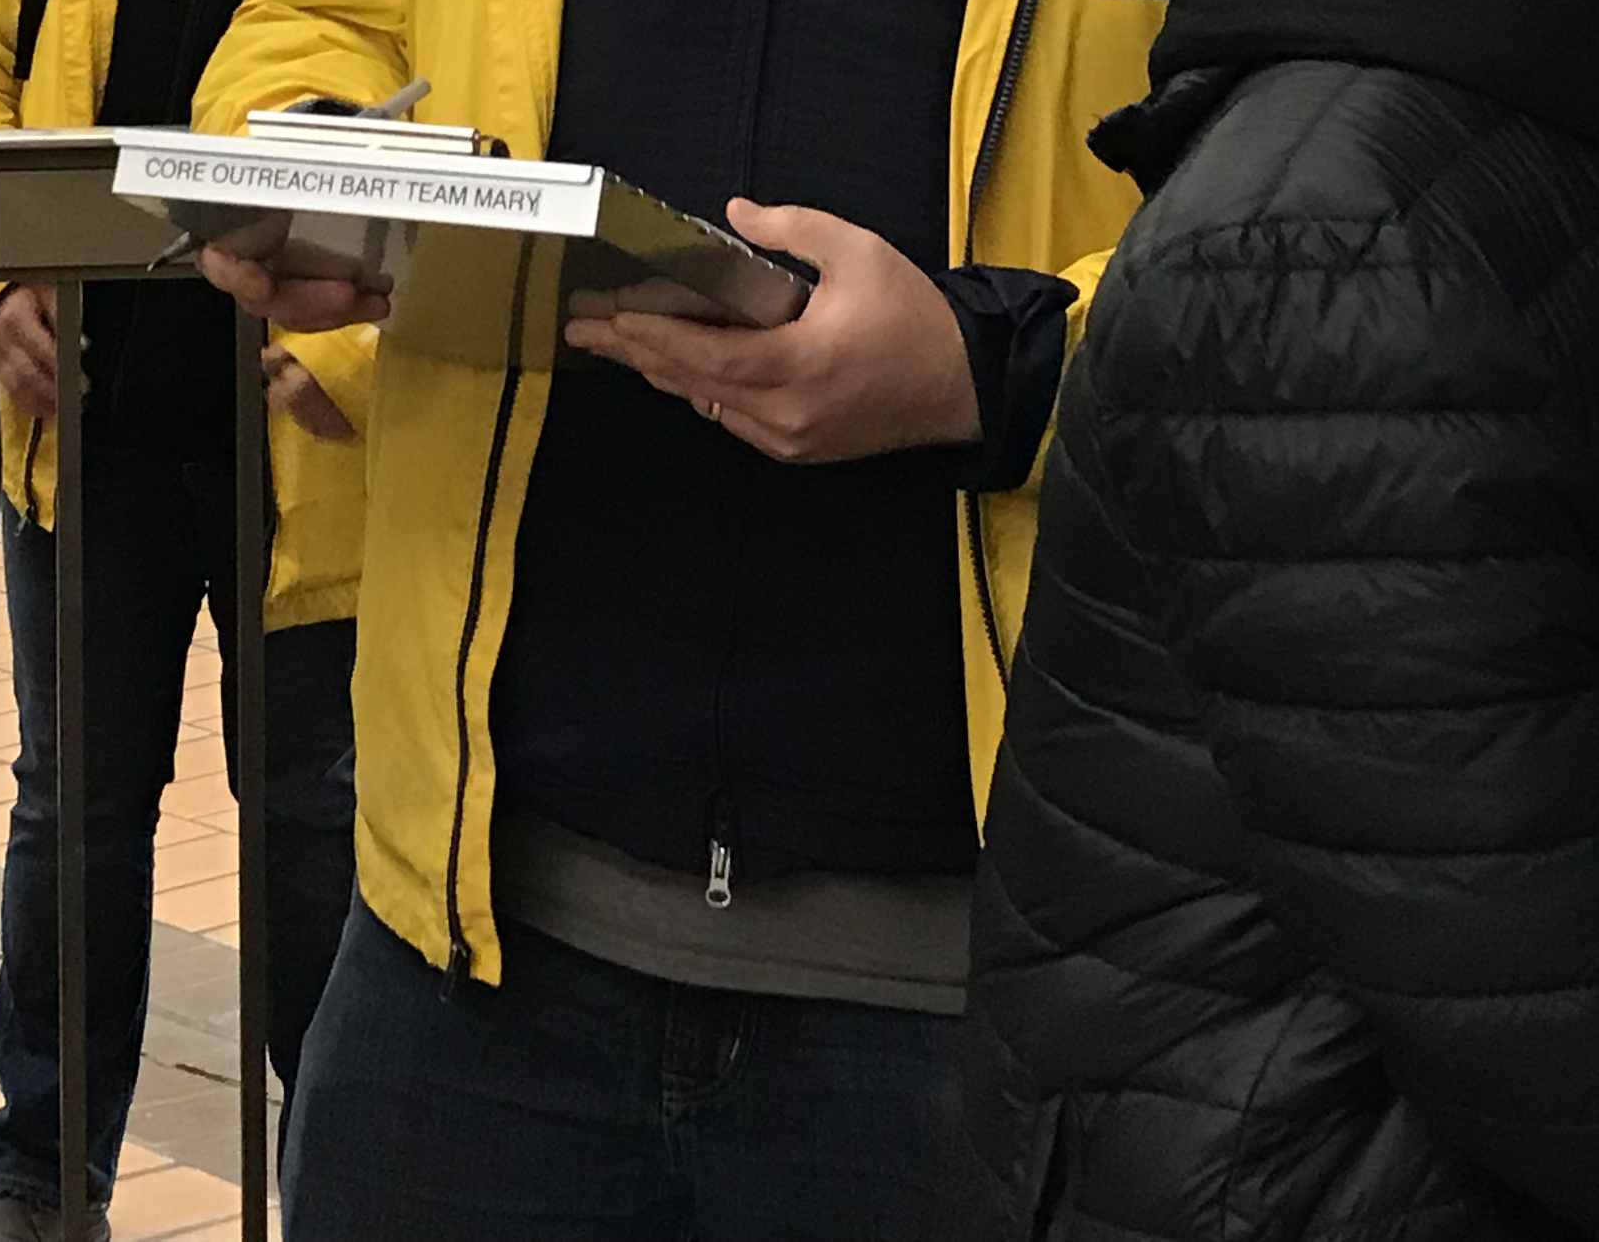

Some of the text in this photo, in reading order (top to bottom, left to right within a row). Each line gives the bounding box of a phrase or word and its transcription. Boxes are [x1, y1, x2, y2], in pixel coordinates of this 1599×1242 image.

[145, 156, 543, 215] CORE OUTREACH BART TEAM MARY
